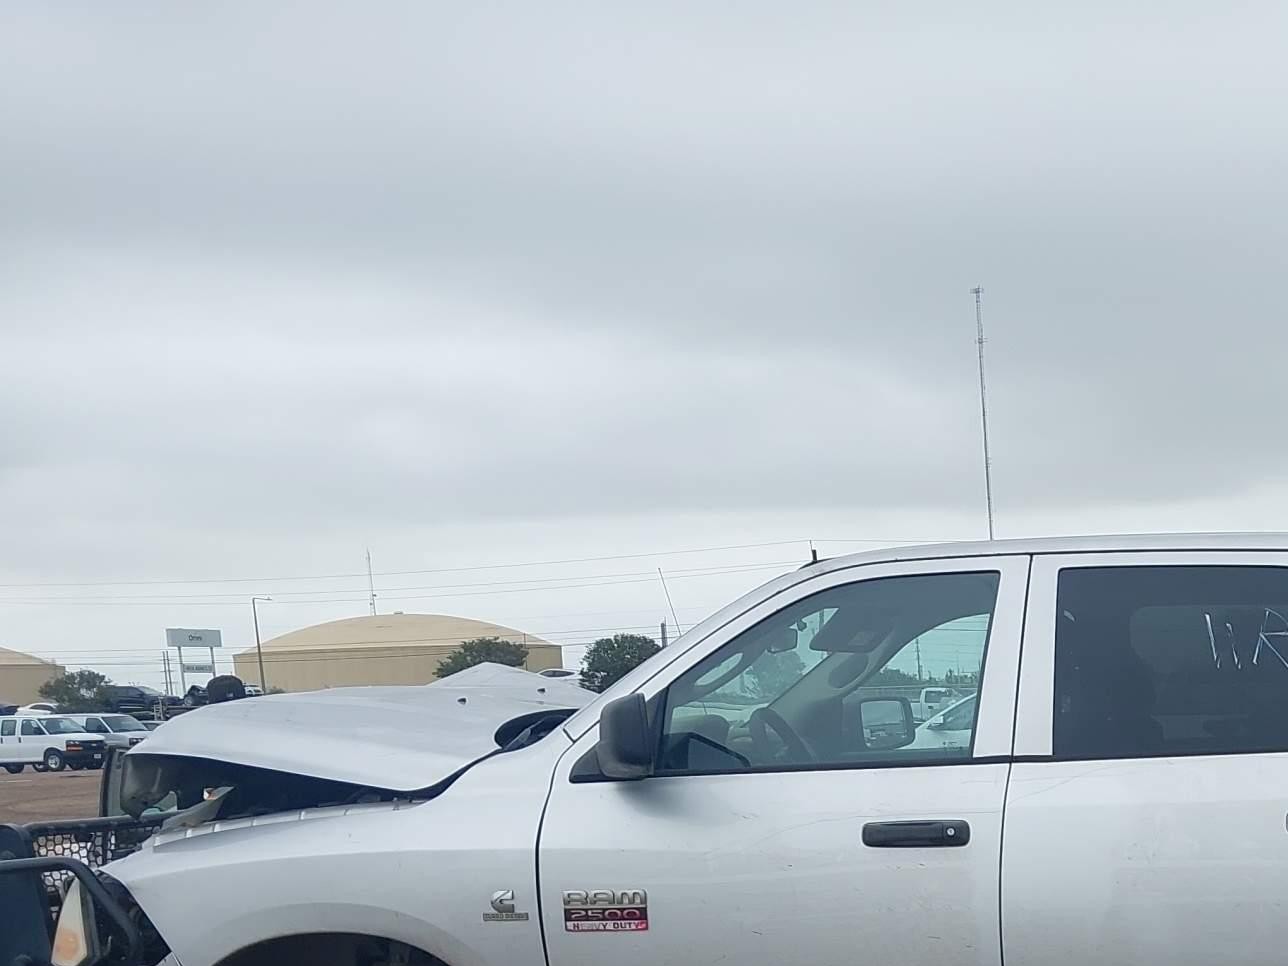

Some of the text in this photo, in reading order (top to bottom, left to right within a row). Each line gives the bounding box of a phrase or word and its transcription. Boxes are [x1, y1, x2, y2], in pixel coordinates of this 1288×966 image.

[563, 889, 648, 905] RAM
[570, 909, 641, 920] 2500
[572, 922, 609, 930] HVY
